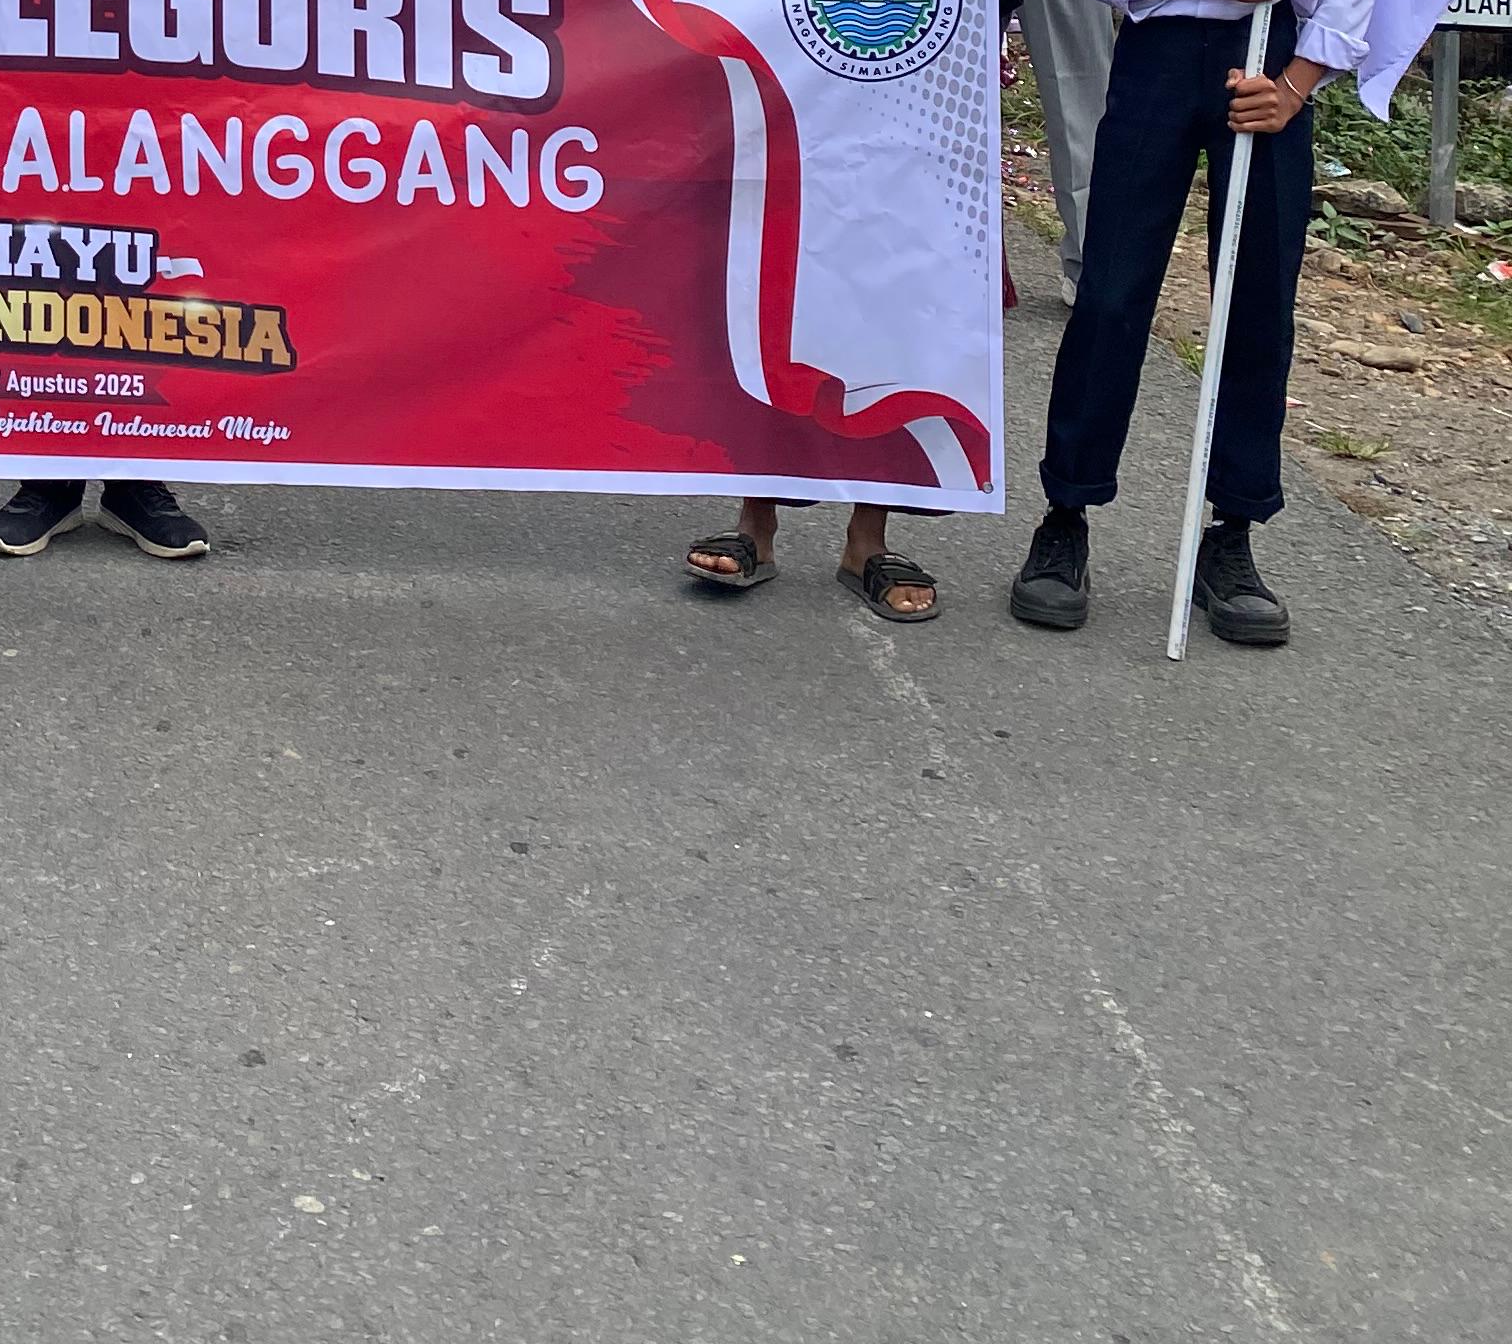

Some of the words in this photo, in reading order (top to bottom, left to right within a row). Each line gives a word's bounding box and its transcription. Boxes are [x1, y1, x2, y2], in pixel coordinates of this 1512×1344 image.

[792, 4, 833, 63] NAGARI
[840, 6, 953, 76] SIMALANGGANG
[6, 370, 88, 398] Agustus
[94, 373, 145, 397] 2025
[94, 411, 214, 439] Indonesai
[217, 415, 292, 445] Maju
